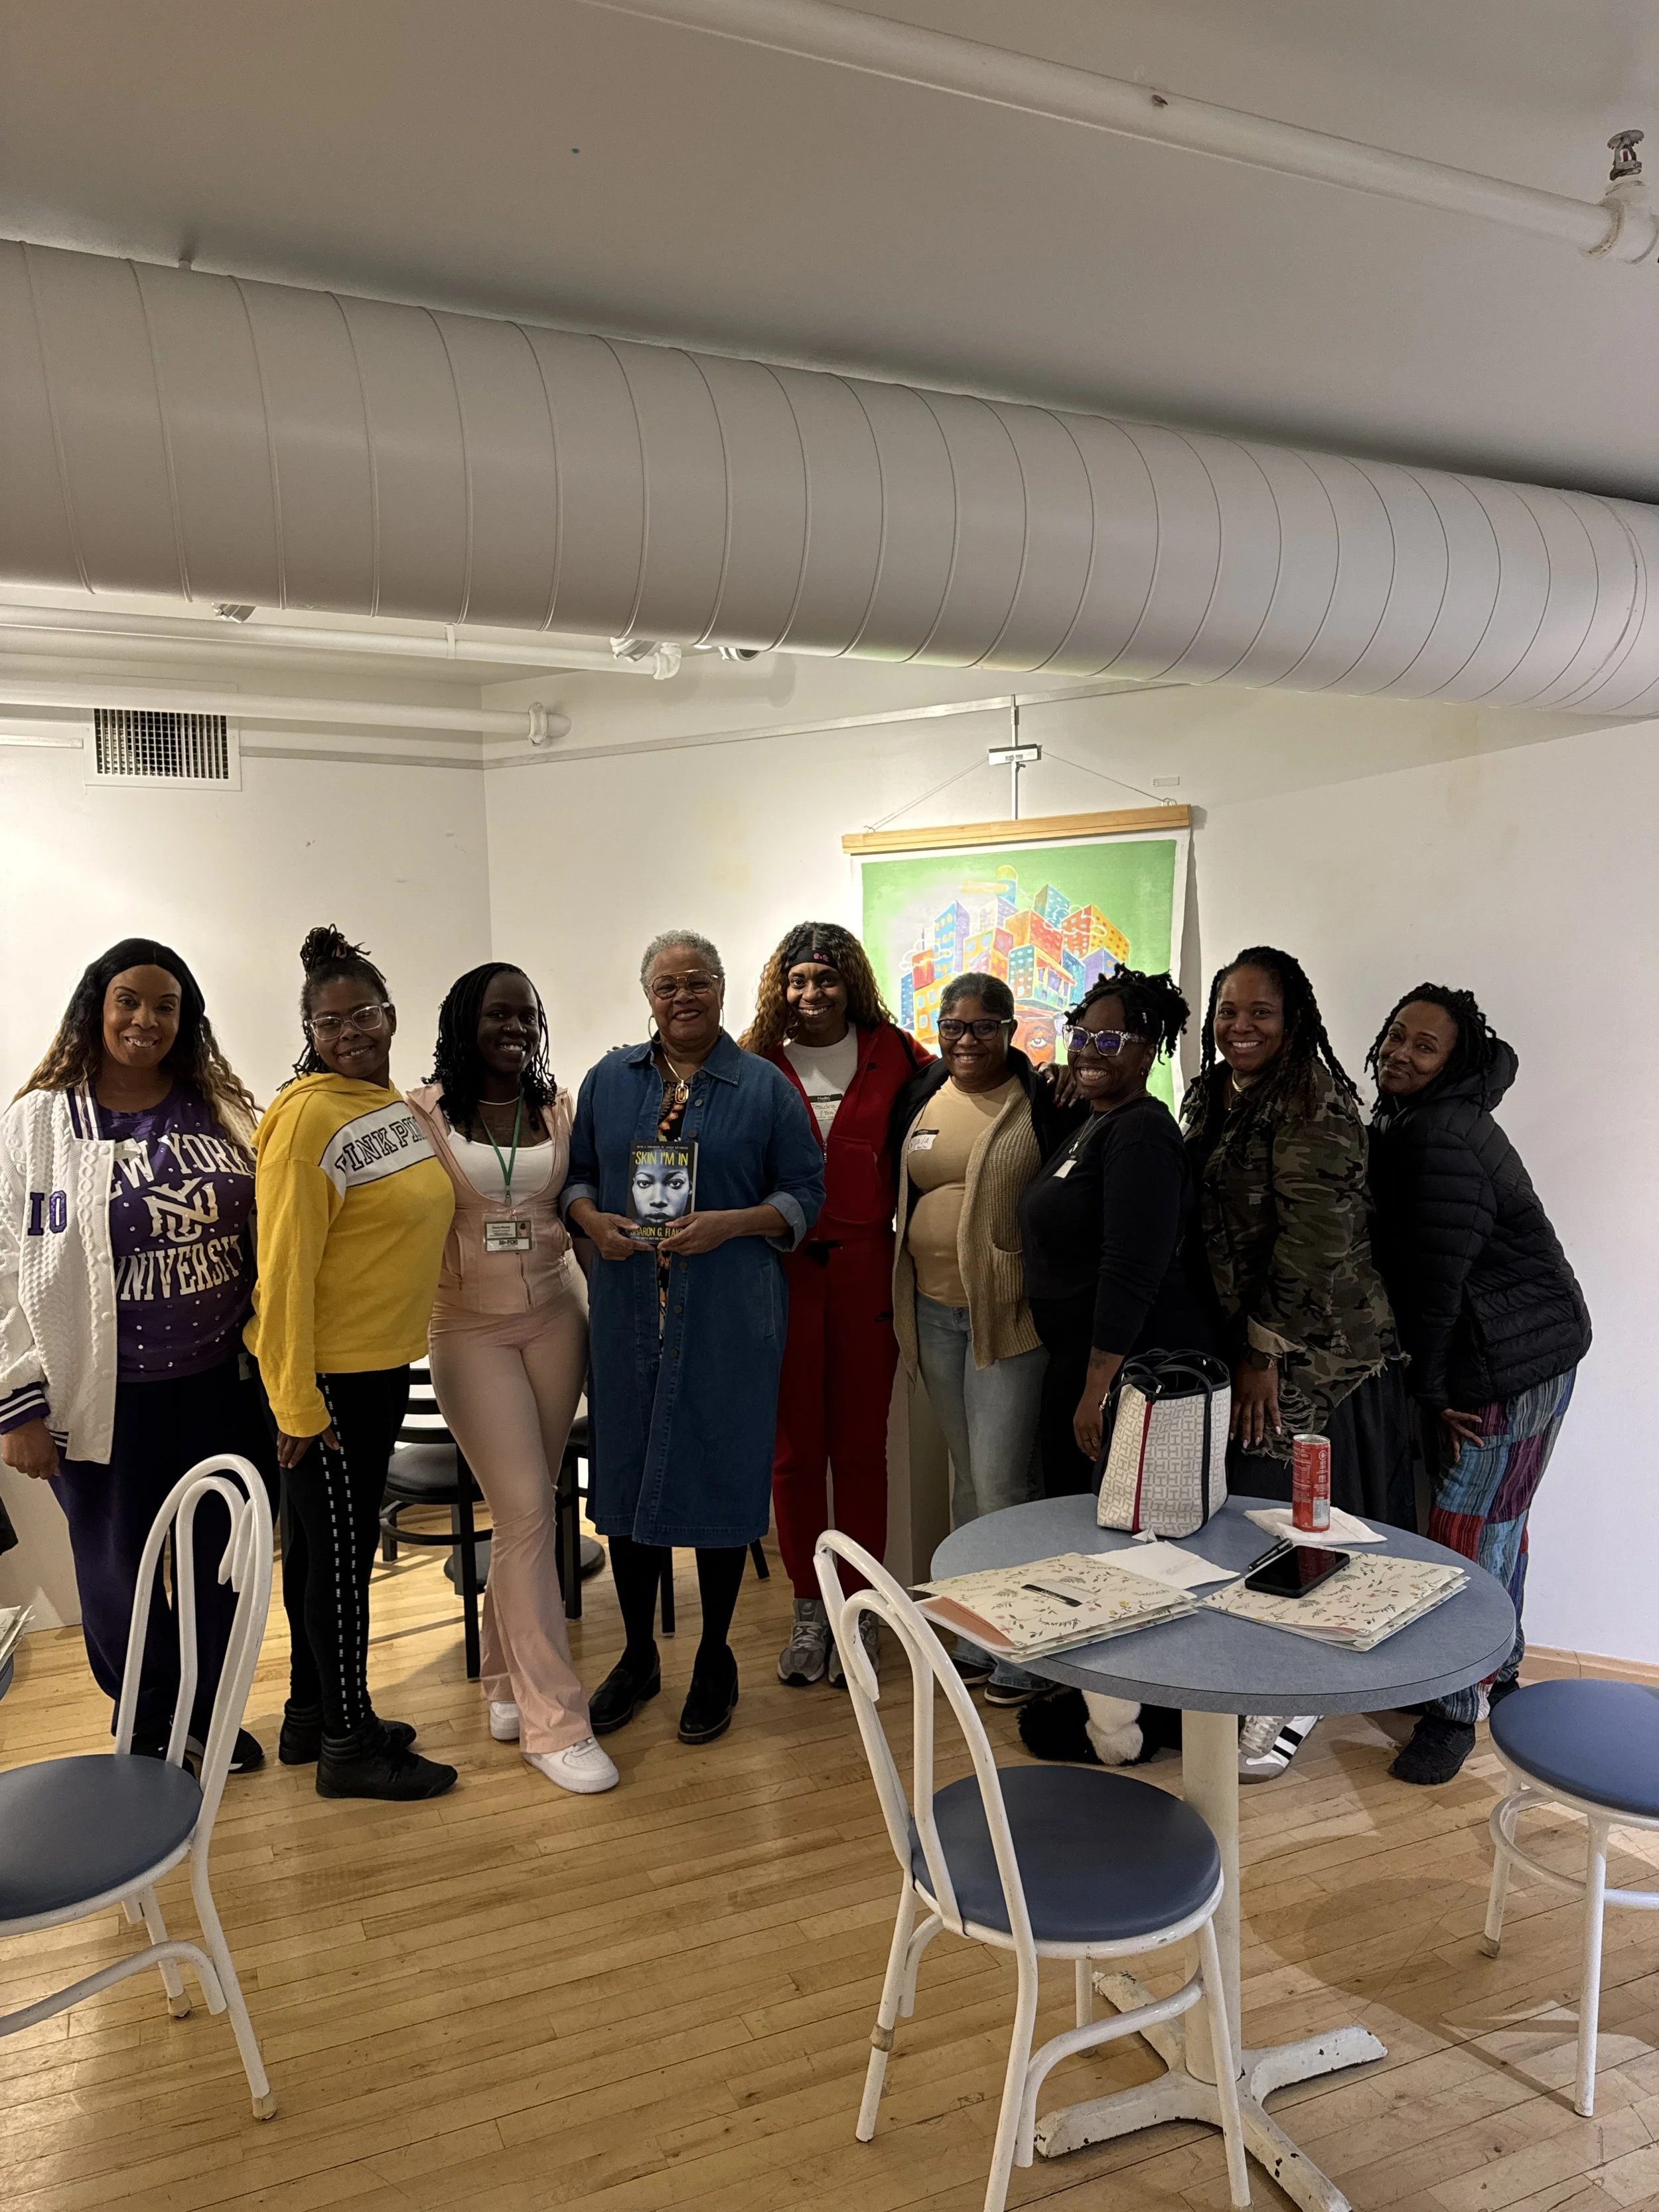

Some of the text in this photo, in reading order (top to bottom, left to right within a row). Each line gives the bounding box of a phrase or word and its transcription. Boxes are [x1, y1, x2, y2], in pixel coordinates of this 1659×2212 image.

[635, 1151, 688, 1166] SKIN I'M IN
